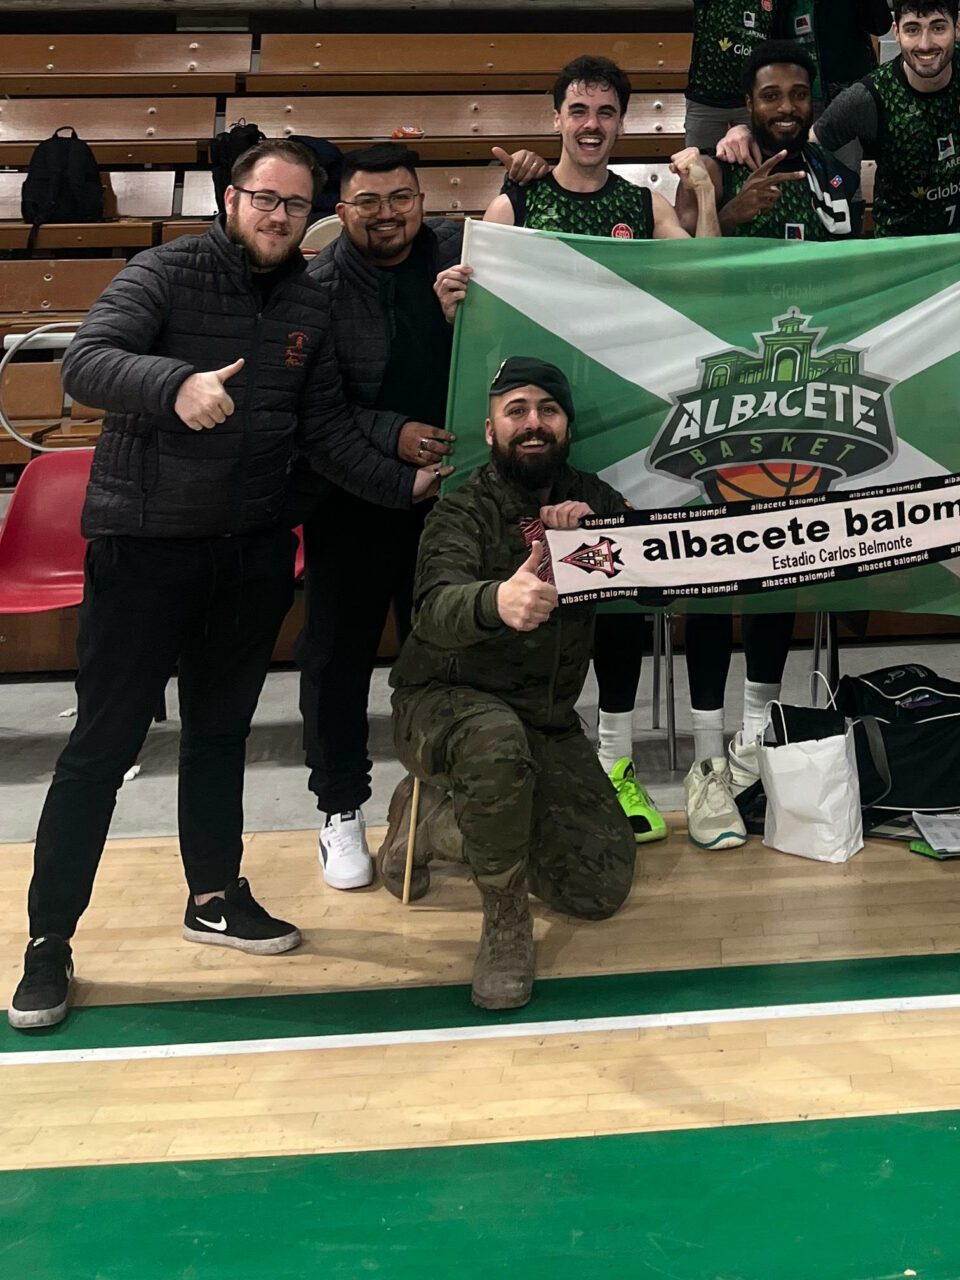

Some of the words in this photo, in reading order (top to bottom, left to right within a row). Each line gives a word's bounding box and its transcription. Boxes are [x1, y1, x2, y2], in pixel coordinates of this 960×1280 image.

[944, 204, 957, 227] 7
[669, 381, 882, 447] ALBACETE
[690, 437, 856, 466] BASKET
[750, 499, 787, 511] albacete
[789, 495, 827, 507] balompié
[649, 510, 687, 521] albacete
[689, 506, 728, 518] balompié
[642, 517, 830, 561] albacete
[772, 551, 816, 571] Estadio
[819, 546, 856, 563] Carlos
[859, 535, 913, 557] Belmonte
[857, 560, 892, 572] albacete
[894, 552, 930, 566] balompié
[701, 582, 739, 594] balompié
[761, 577, 797, 588] albacete
[799, 569, 836, 583] balompié
[560, 591, 598, 605] albacete
[600, 587, 639, 599] balompié
